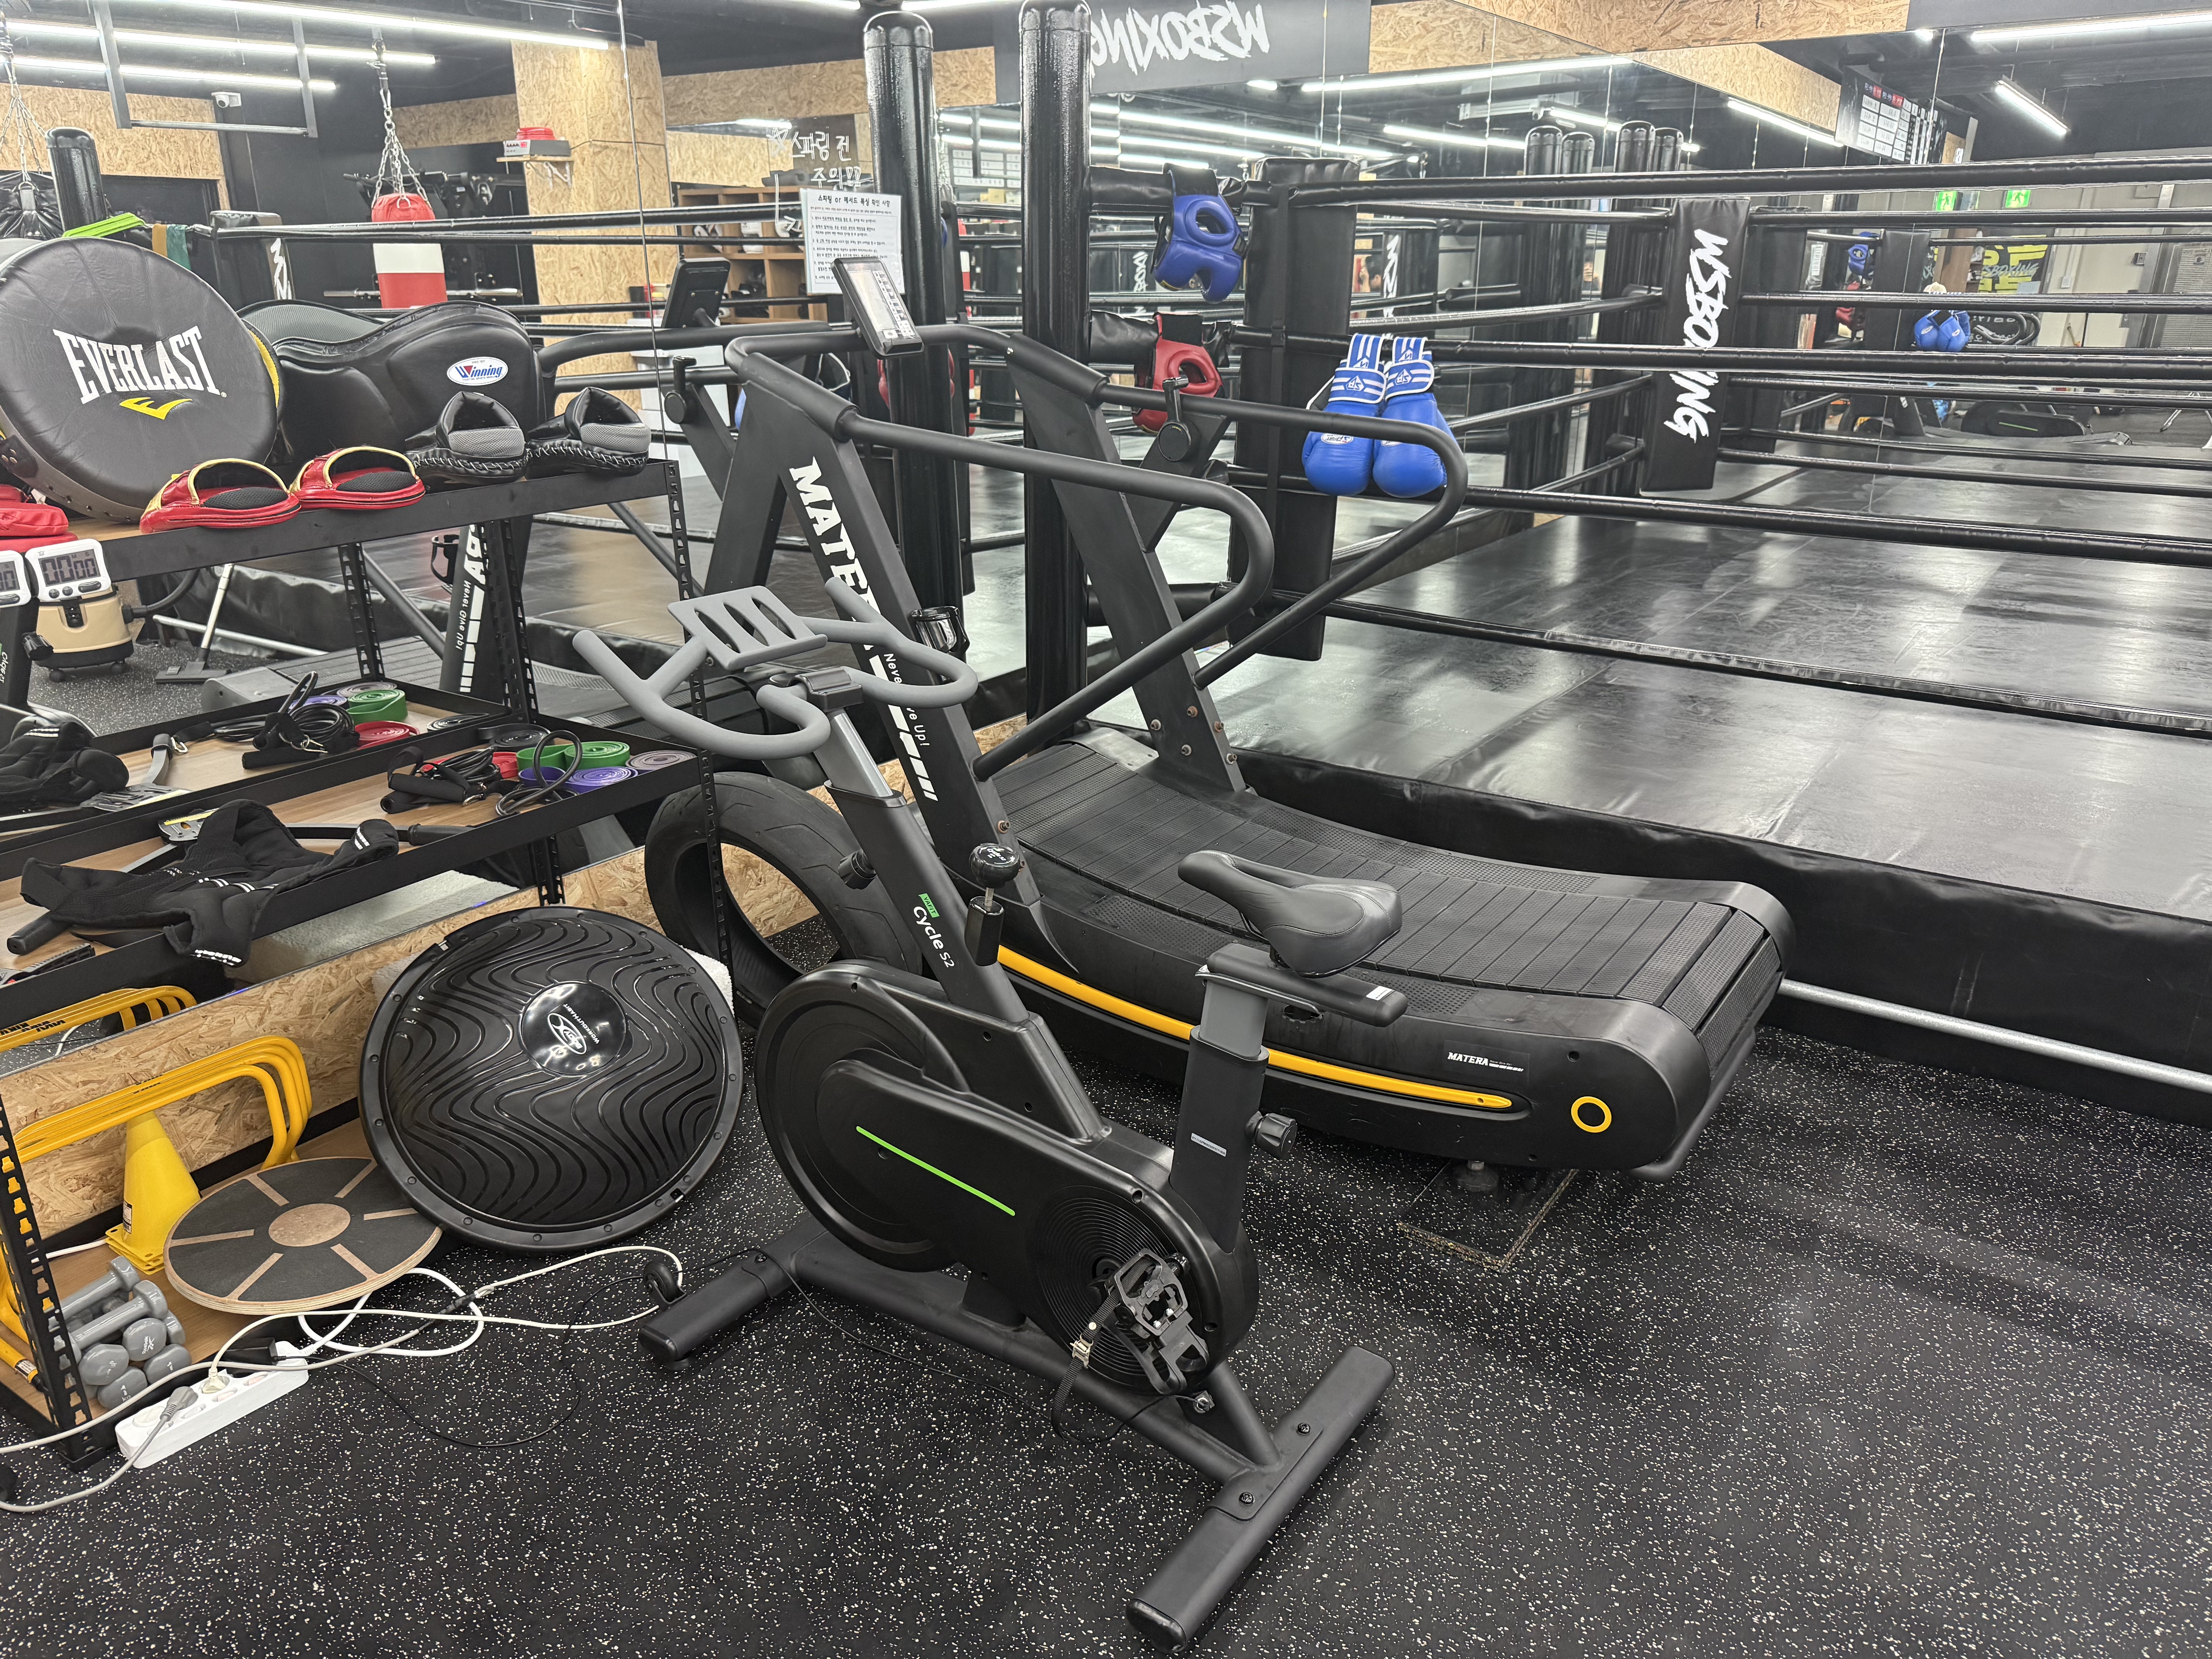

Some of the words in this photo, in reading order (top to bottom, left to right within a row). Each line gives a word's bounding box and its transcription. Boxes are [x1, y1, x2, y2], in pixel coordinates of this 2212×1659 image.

[789, 131, 830, 161] 스파링
[836, 136, 852, 161] 전
[818, 194, 832, 204] 스파링
[1664, 228, 1732, 443] WSBOING
[52, 325, 221, 405] EVERLAST
[455, 365, 503, 378] Winning
[789, 456, 881, 651] MATE
[883, 653, 903, 685] Neve
[907, 706, 919, 722] ve
[911, 724, 931, 748] Up!
[923, 896, 937, 914] YAFIT
[913, 906, 944, 950] Cycle
[939, 951, 955, 968] S2
[1447, 1052, 1489, 1066] MATERA
